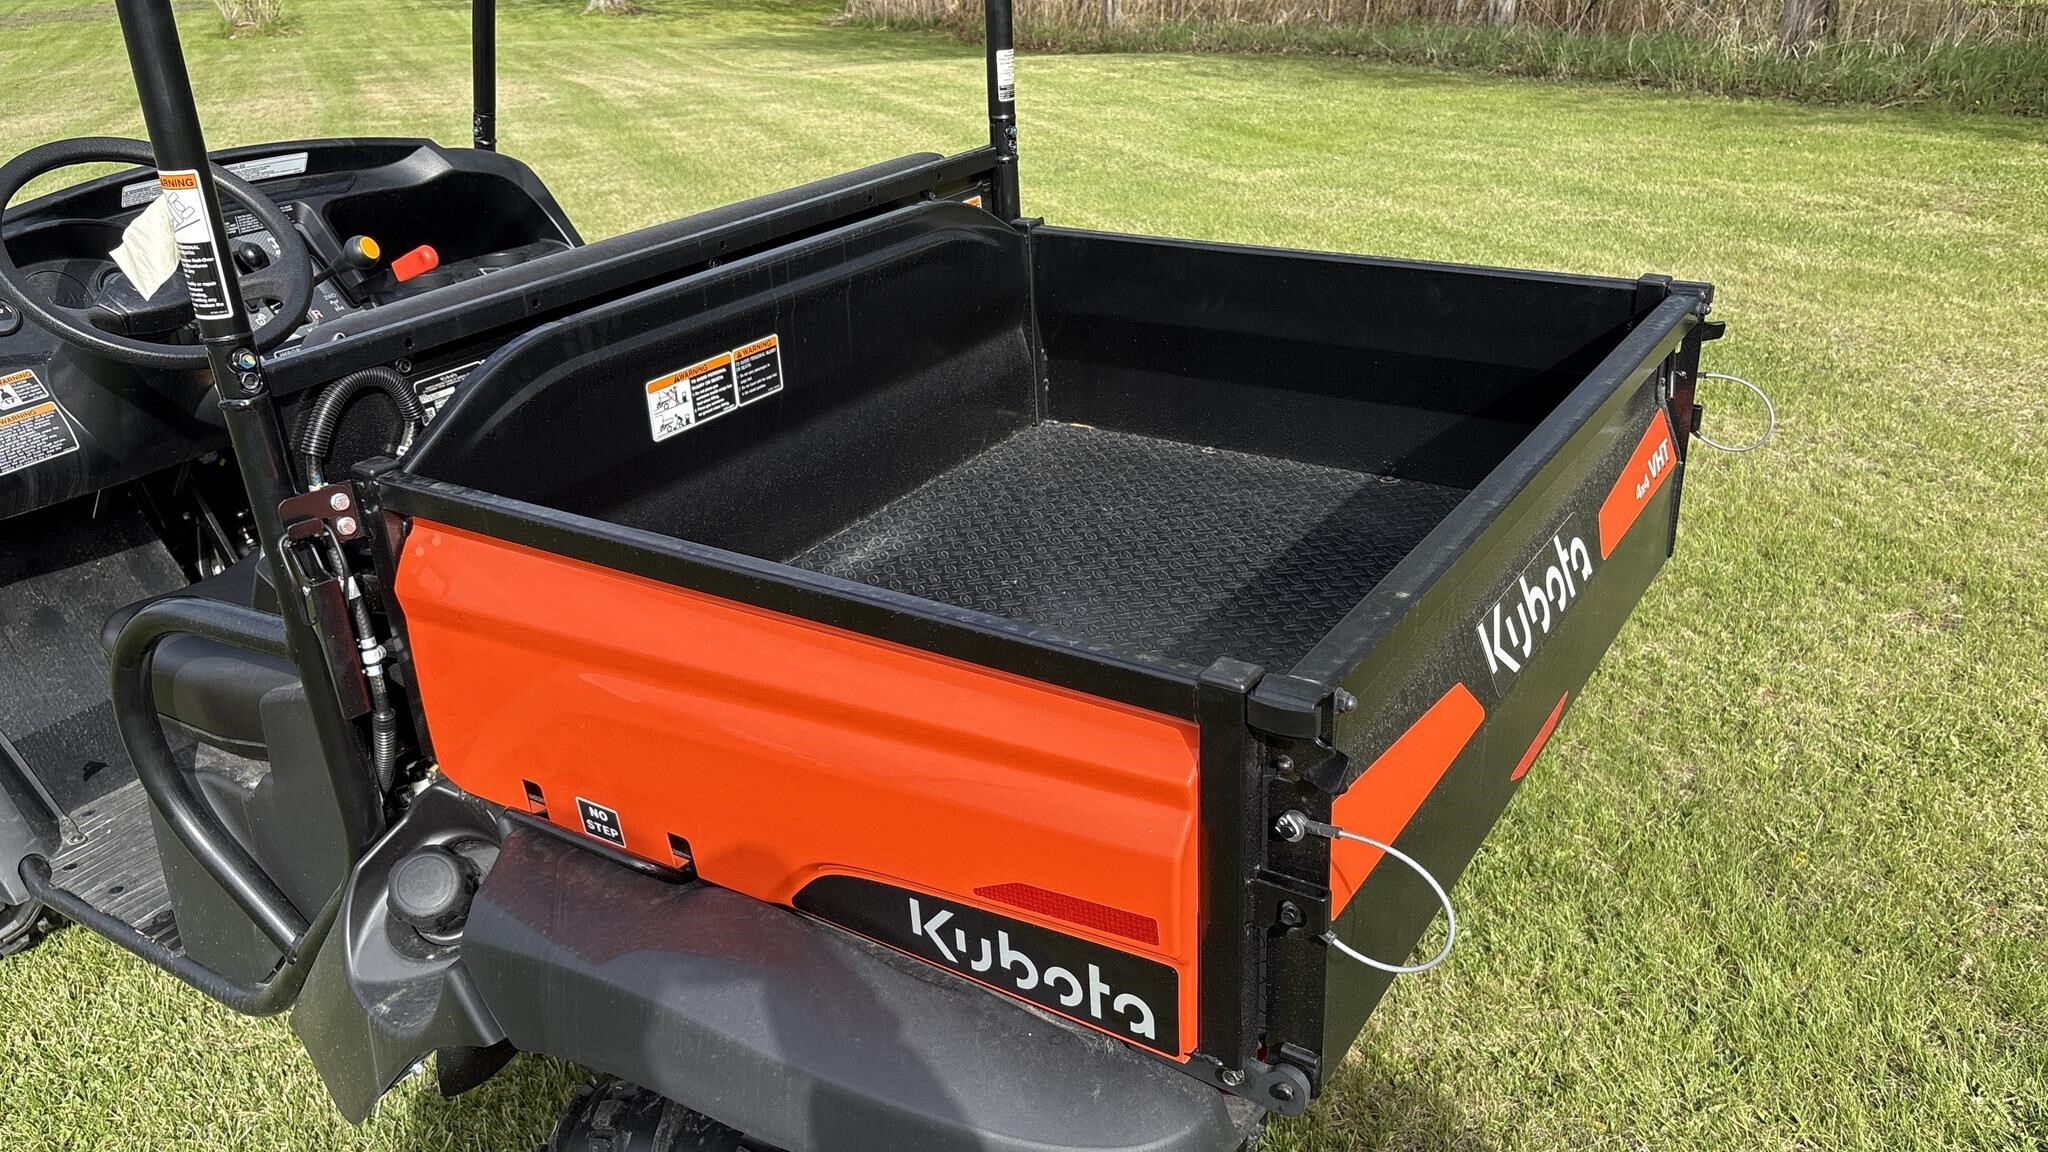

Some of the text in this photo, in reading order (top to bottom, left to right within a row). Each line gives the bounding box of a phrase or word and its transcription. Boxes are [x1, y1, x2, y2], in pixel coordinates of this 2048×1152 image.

[743, 341, 771, 354] WARNING
[679, 364, 708, 380] WARNING
[1635, 438, 1669, 500] 4x4 VHT
[1477, 534, 1593, 674] Kubota
[588, 806, 608, 822] NO
[587, 819, 619, 837] STEP
[909, 897, 1156, 1041] Kubota
